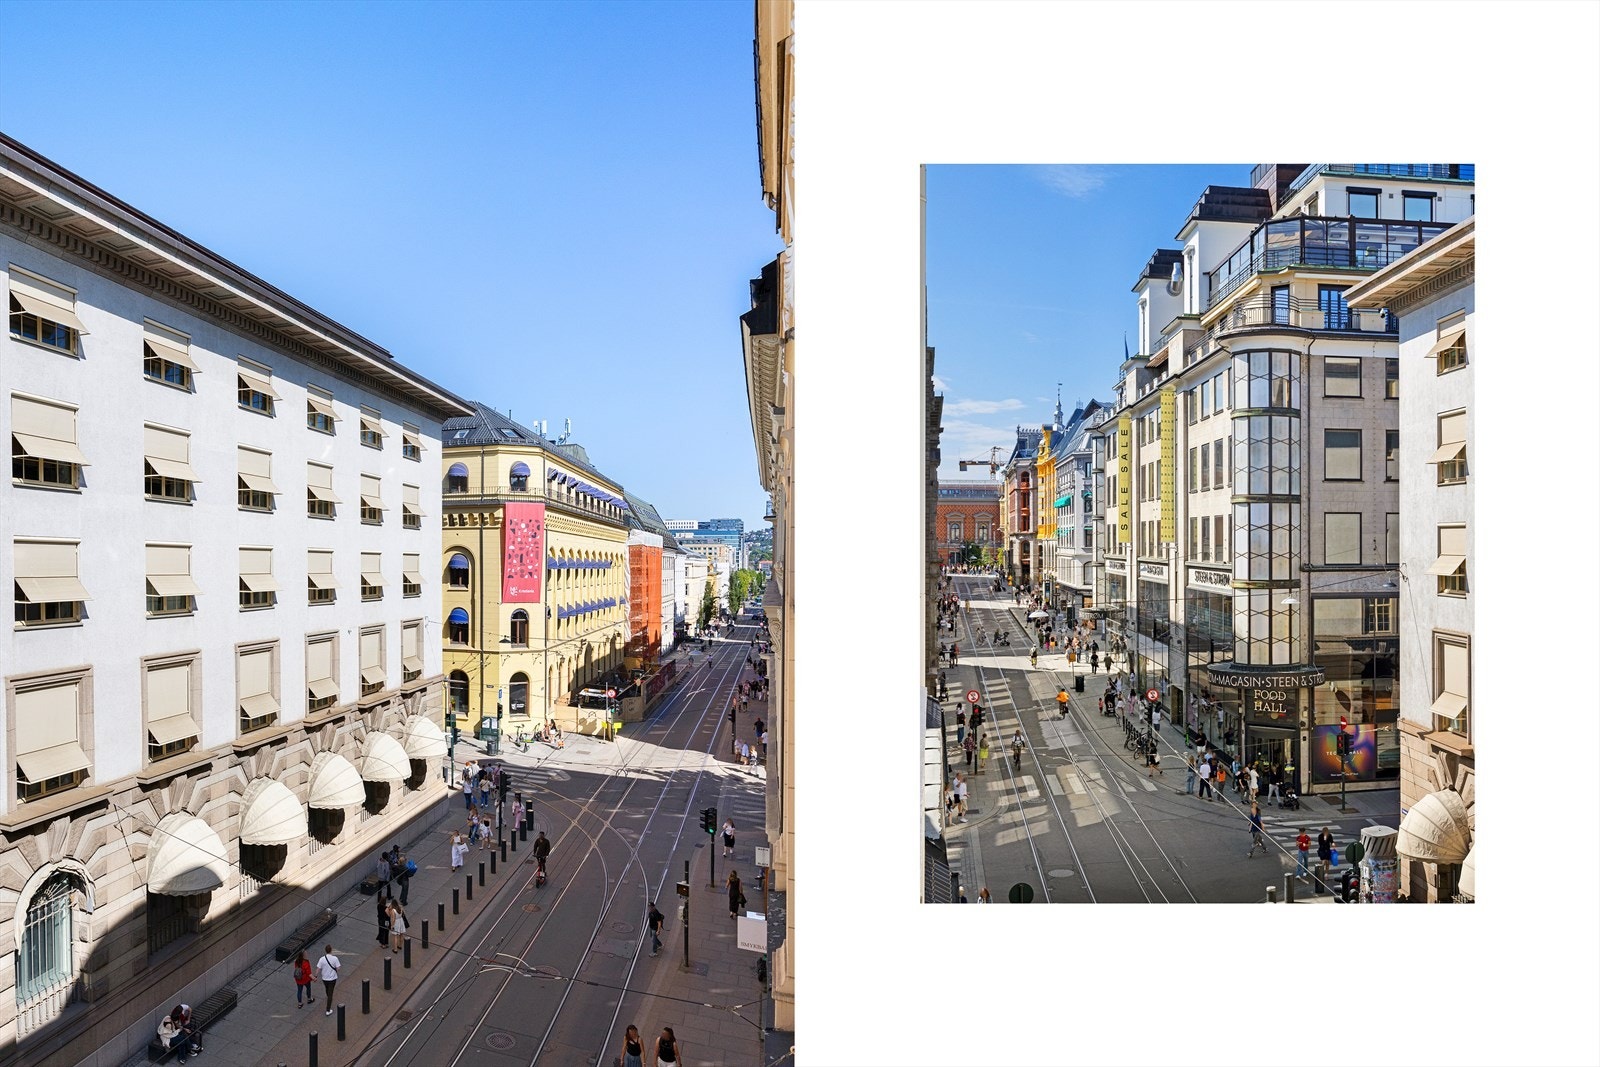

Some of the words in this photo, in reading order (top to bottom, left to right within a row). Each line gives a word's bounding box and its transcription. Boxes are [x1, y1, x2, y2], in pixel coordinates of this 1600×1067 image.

[1266, 676, 1298, 688] STEEN
[1301, 675, 1307, 686] &
[1254, 690, 1286, 700] FOOD
[1254, 702, 1286, 713] HALL
